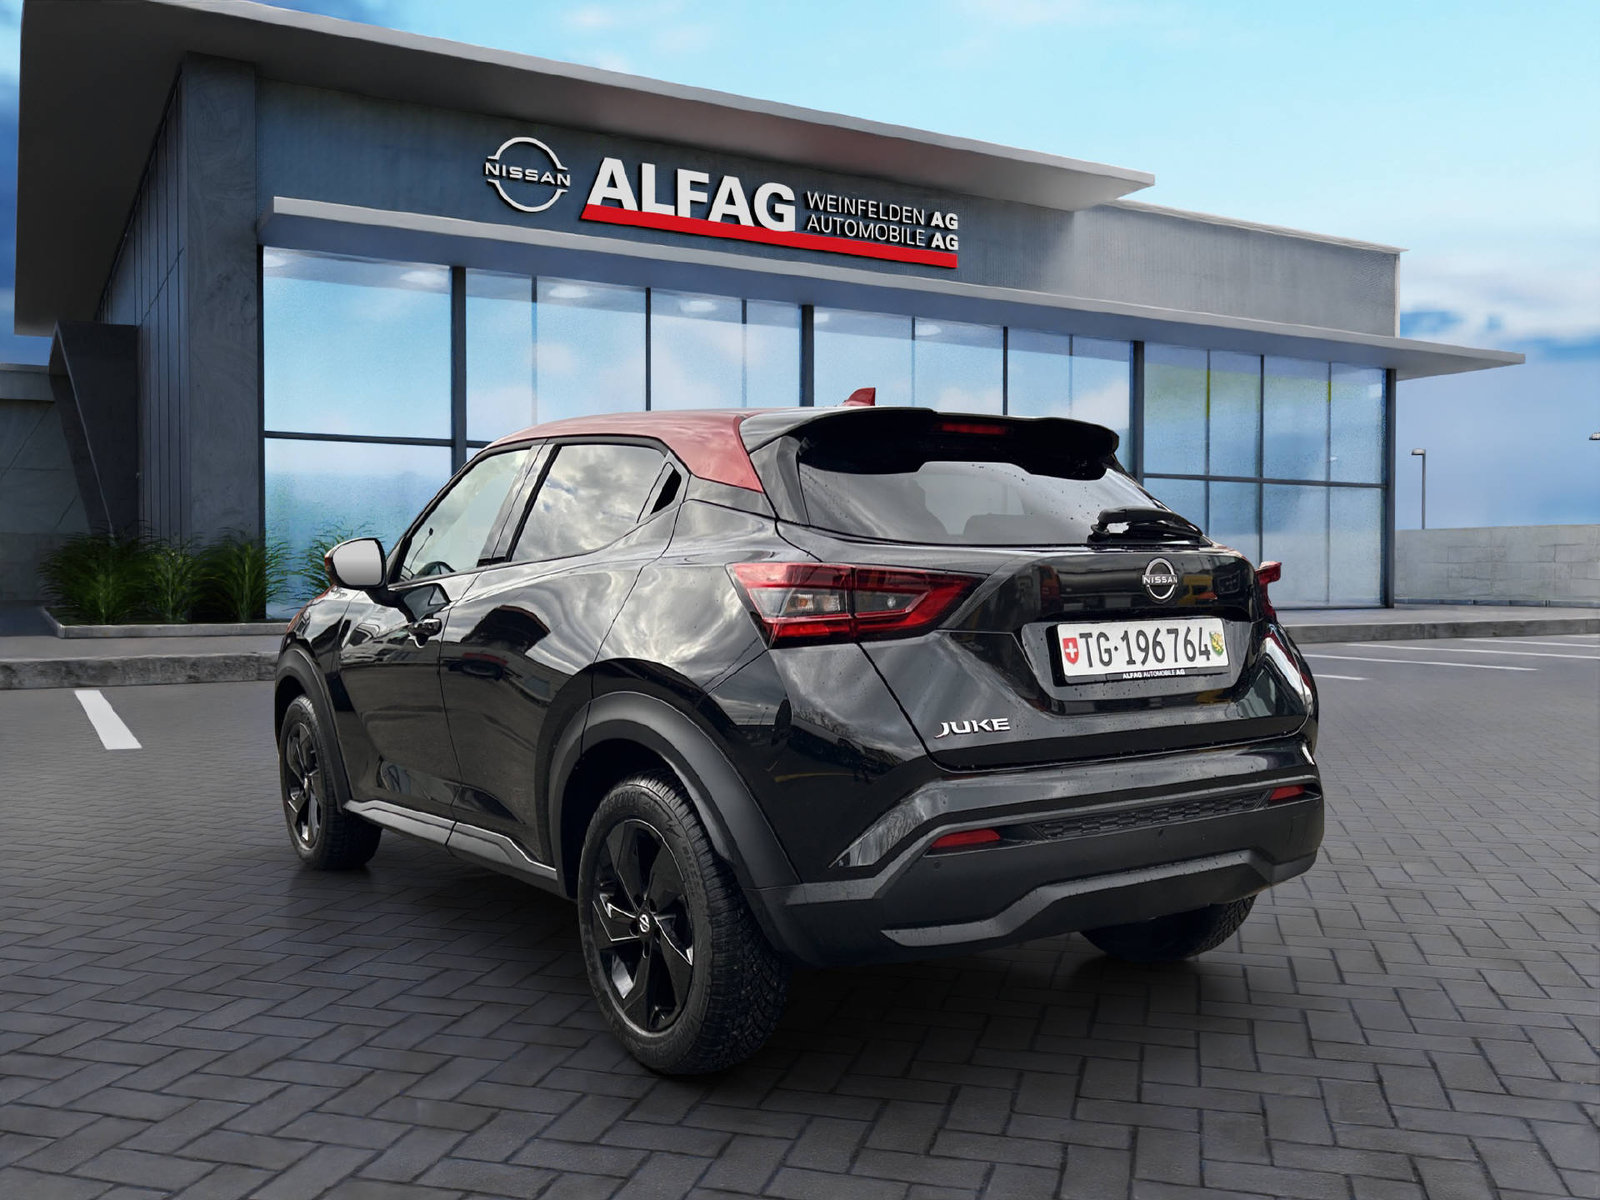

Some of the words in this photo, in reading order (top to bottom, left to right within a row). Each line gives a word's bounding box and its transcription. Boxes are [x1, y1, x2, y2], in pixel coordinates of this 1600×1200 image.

[485, 161, 571, 186] NISSAN
[587, 157, 796, 231] ALFAG
[807, 191, 925, 225] WEINFELDEN
[930, 211, 959, 230] AG
[807, 214, 926, 246] AUTOMOBILE
[930, 232, 959, 250] AG
[1143, 575, 1178, 584] NISSAN
[934, 718, 1011, 739] JUKE
